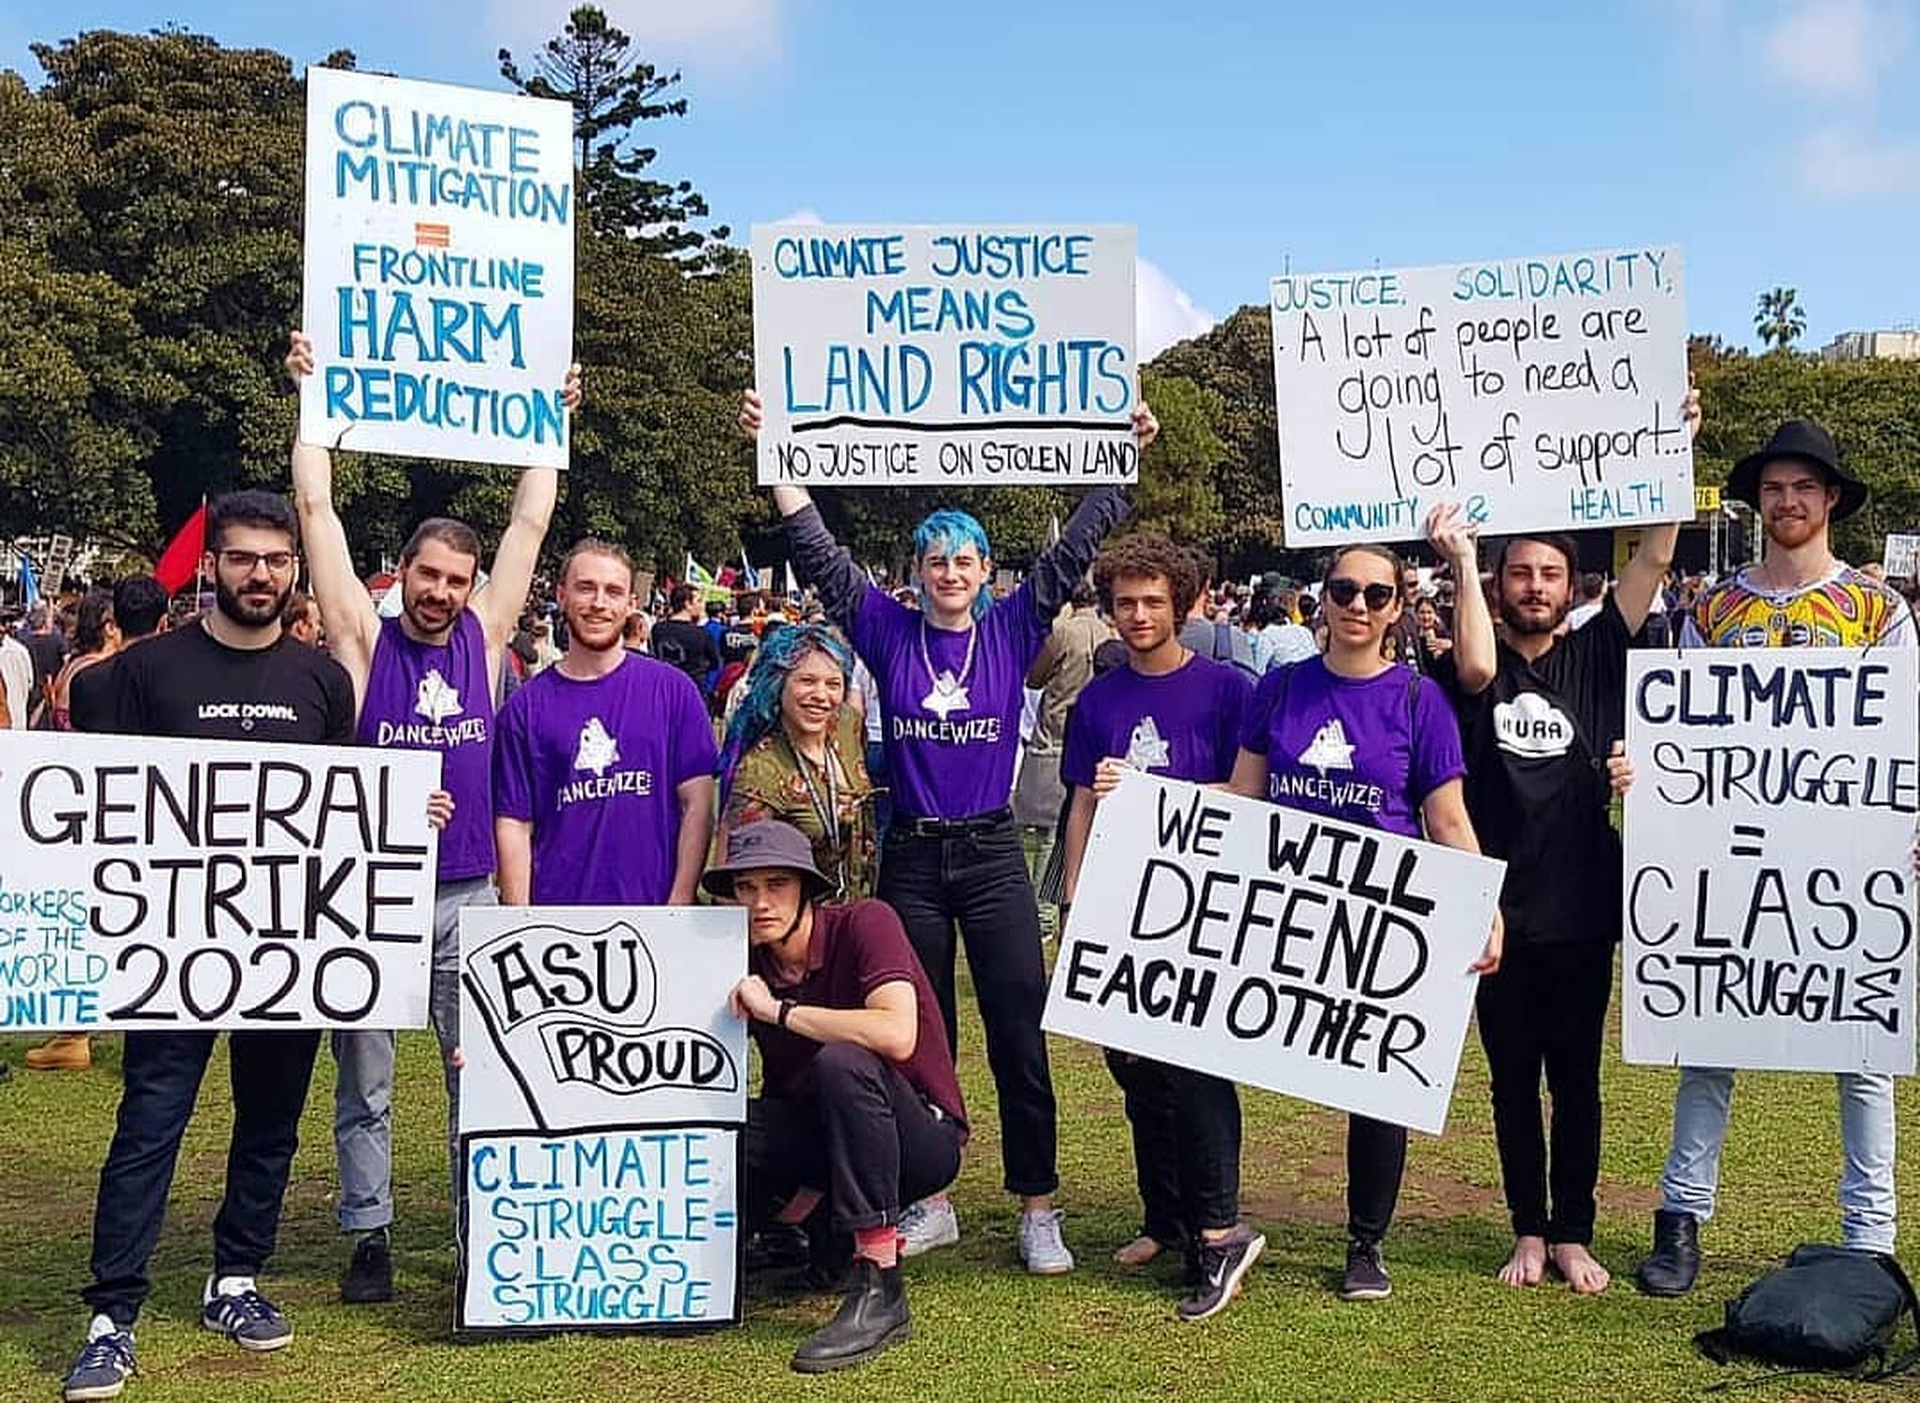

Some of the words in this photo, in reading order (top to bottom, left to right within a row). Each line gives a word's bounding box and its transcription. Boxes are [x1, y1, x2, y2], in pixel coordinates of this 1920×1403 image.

[335, 100, 540, 174] CLIMATE
[336, 150, 569, 225] MITIGATION
[353, 243, 544, 298] FRONTLINE
[774, 236, 906, 278] CLIMATE
[932, 236, 1094, 277] JUSTICE
[336, 286, 526, 369] HARM
[867, 287, 1036, 338] MEANS
[1301, 312, 1326, 362] A
[1343, 313, 1392, 360] lot
[1405, 307, 1437, 360] of
[1456, 303, 1561, 372] people
[1581, 307, 1649, 342] are
[325, 366, 566, 447] REDUCTION
[784, 345, 933, 415] LAND
[959, 340, 1131, 414] RIGHTS
[1336, 367, 1442, 459] going
[1463, 354, 1505, 398] to
[1525, 348, 1601, 393] need
[1611, 354, 1639, 395] a
[777, 443, 811, 478] NO
[818, 443, 918, 475] JUSTICE
[938, 443, 973, 474] ON
[981, 442, 1071, 474] STOLEN
[1081, 441, 1137, 477] LAND
[1385, 411, 1463, 498] lot
[1480, 412, 1521, 484] of
[1535, 400, 1688, 486] support...
[1295, 497, 1420, 531] COMMUNITY
[1465, 495, 1491, 524] &
[1570, 481, 1665, 521] HEALTH
[199, 704, 240, 719] LOCK
[893, 715, 1000, 746] DANCEWIZE
[1636, 664, 1889, 728] CLIMATE
[20, 761, 428, 855] GENERAL
[1653, 741, 1918, 814] STRUGGLE
[1159, 787, 1231, 857] WE
[1270, 813, 1436, 916] WILL
[0, 882, 88, 926] ORKERS
[89, 853, 423, 944] STRIKE
[1131, 858, 1429, 1000] DEFEND
[1629, 865, 1912, 963] CLASS
[38, 927, 86, 951] THE
[105, 941, 382, 1023] 2020
[491, 941, 640, 1022] ASU
[1065, 940, 1217, 1028] EACH
[1227, 976, 1431, 1088] OTHER
[1636, 953, 1900, 1033] STRUGGLE
[557, 1028, 724, 1087] PROUD
[472, 1134, 711, 1193] CLIMATE
[487, 1242, 689, 1284] CLASS
[492, 1280, 712, 1323] STRUGGLE
